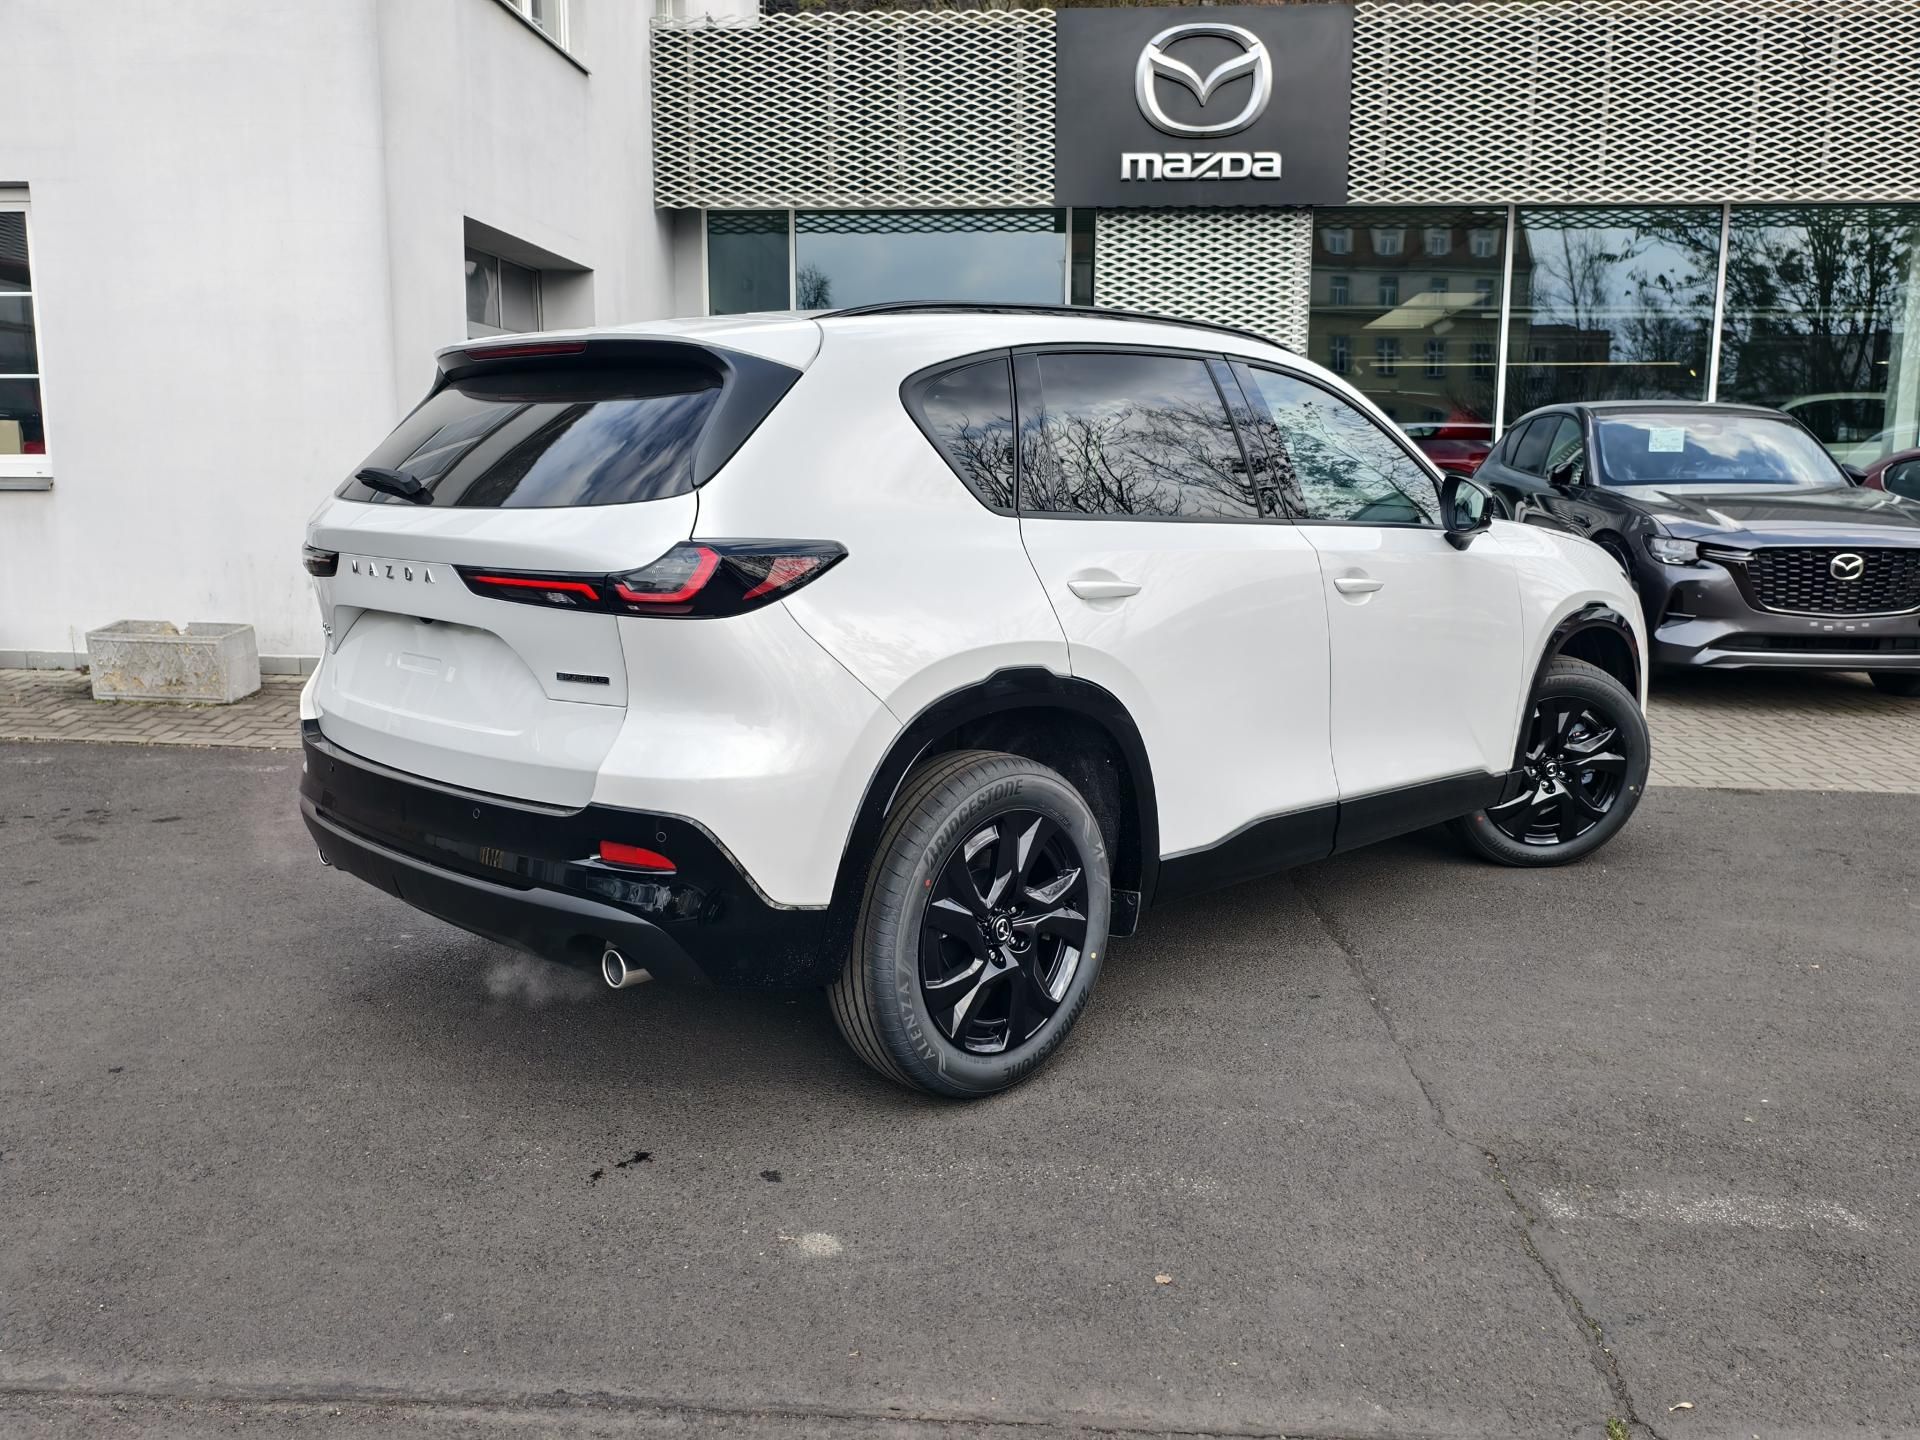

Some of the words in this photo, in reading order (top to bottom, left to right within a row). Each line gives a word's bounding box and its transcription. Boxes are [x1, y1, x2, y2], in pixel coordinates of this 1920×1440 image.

[351, 559, 436, 584] MAZDA
[922, 779, 1024, 872] BRIDGESTONE
[899, 981, 936, 1060] ALENZA
